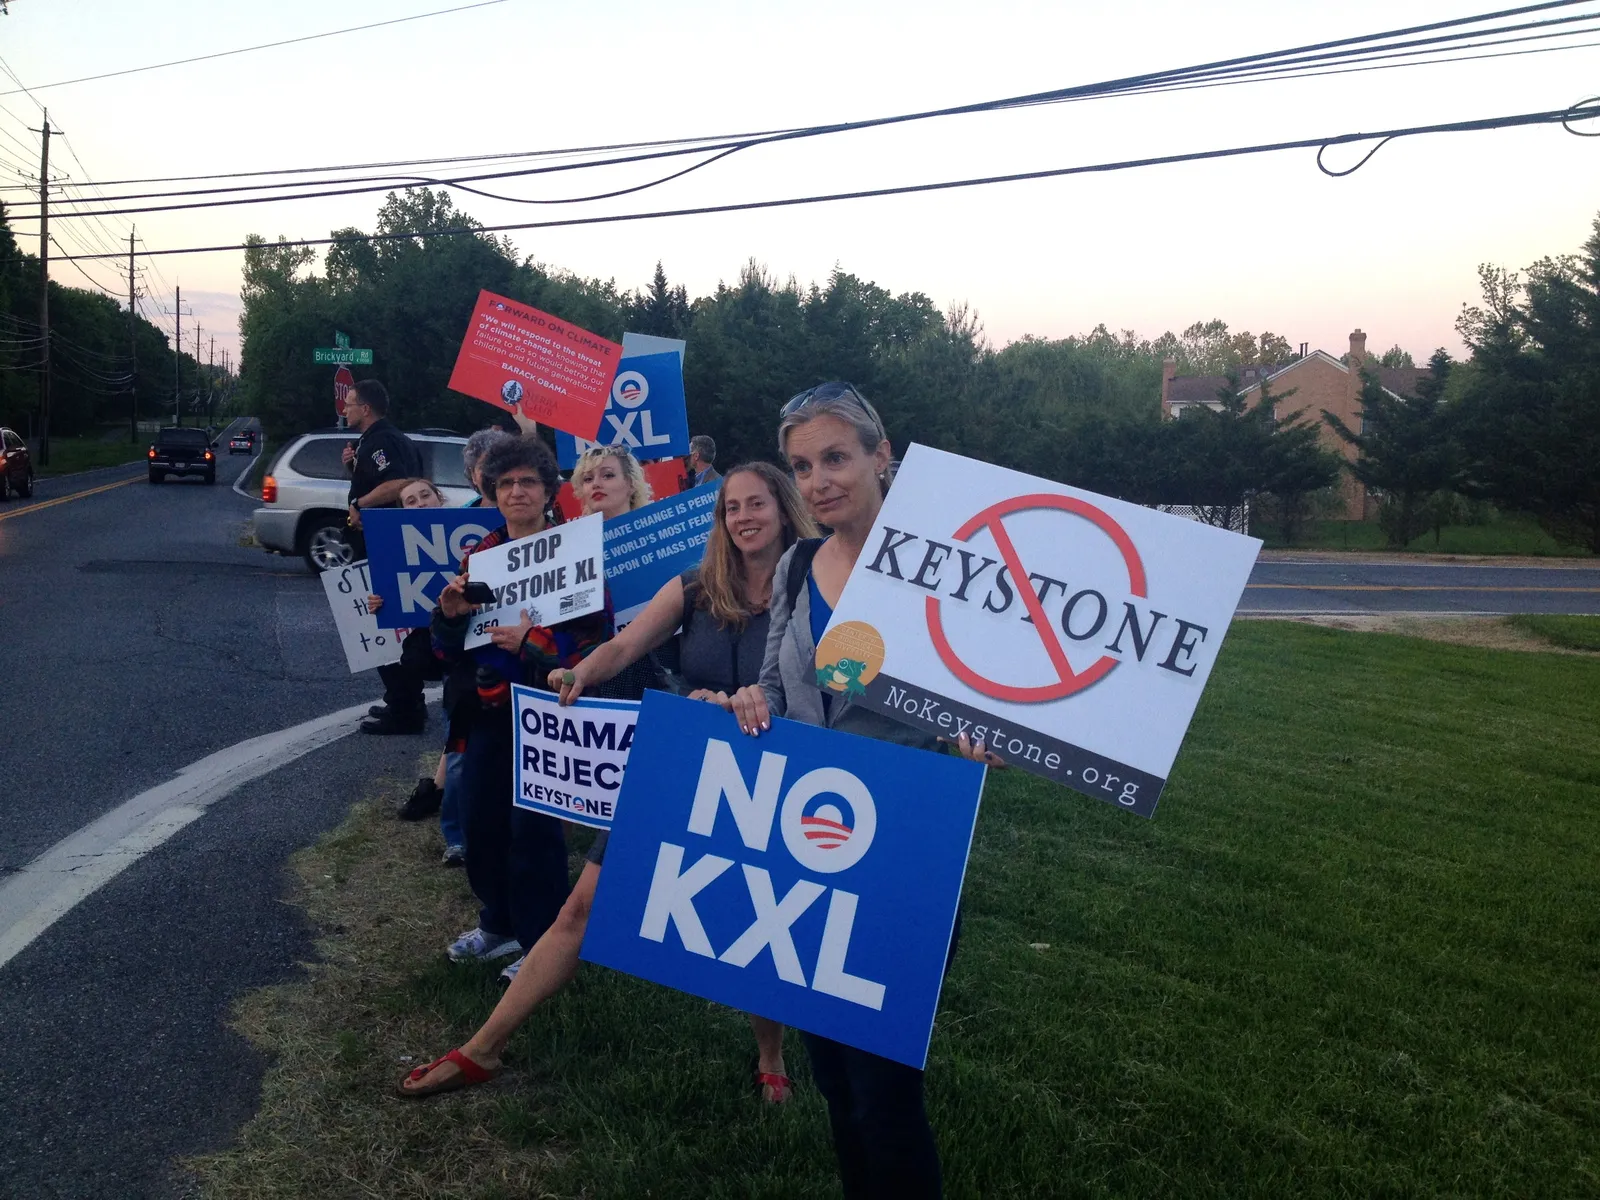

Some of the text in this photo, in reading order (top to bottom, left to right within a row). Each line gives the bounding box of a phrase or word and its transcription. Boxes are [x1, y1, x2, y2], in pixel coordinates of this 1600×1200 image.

[489, 300, 611, 355] FORWARD ON CLIMATE
[501, 322, 516, 330] will
[518, 328, 546, 344] respond
[552, 342, 561, 350] to
[563, 346, 576, 356] the
[578, 353, 602, 368] threat
[315, 351, 354, 362] Brickyard
[360, 351, 369, 359] Rd
[473, 339, 507, 356] children
[508, 352, 524, 362] and
[526, 358, 549, 373] future
[476, 330, 604, 386] failure to do so would betray our
[490, 328, 520, 342] climate
[523, 339, 554, 357] change,
[556, 353, 589, 372] knowing
[590, 368, 606, 378] that
[334, 382, 352, 401] STO
[502, 362, 567, 395] BARACK OBAMA
[634, 507, 675, 531] CHANGE
[676, 503, 687, 515] IS
[507, 533, 562, 572] STOP
[610, 533, 657, 560] WORLD'S
[658, 520, 687, 541] MOST
[642, 553, 655, 564] OF
[656, 541, 687, 561] MASS
[575, 557, 597, 585] XL
[865, 526, 1208, 677] KEYSTONE
[360, 632, 386, 652] to
[884, 685, 1140, 806] NoKeystone.org
[522, 744, 627, 791] REJEC
[523, 782, 612, 817] KEYSTONE
[687, 737, 876, 874] NO
[639, 841, 886, 1011] KXL
